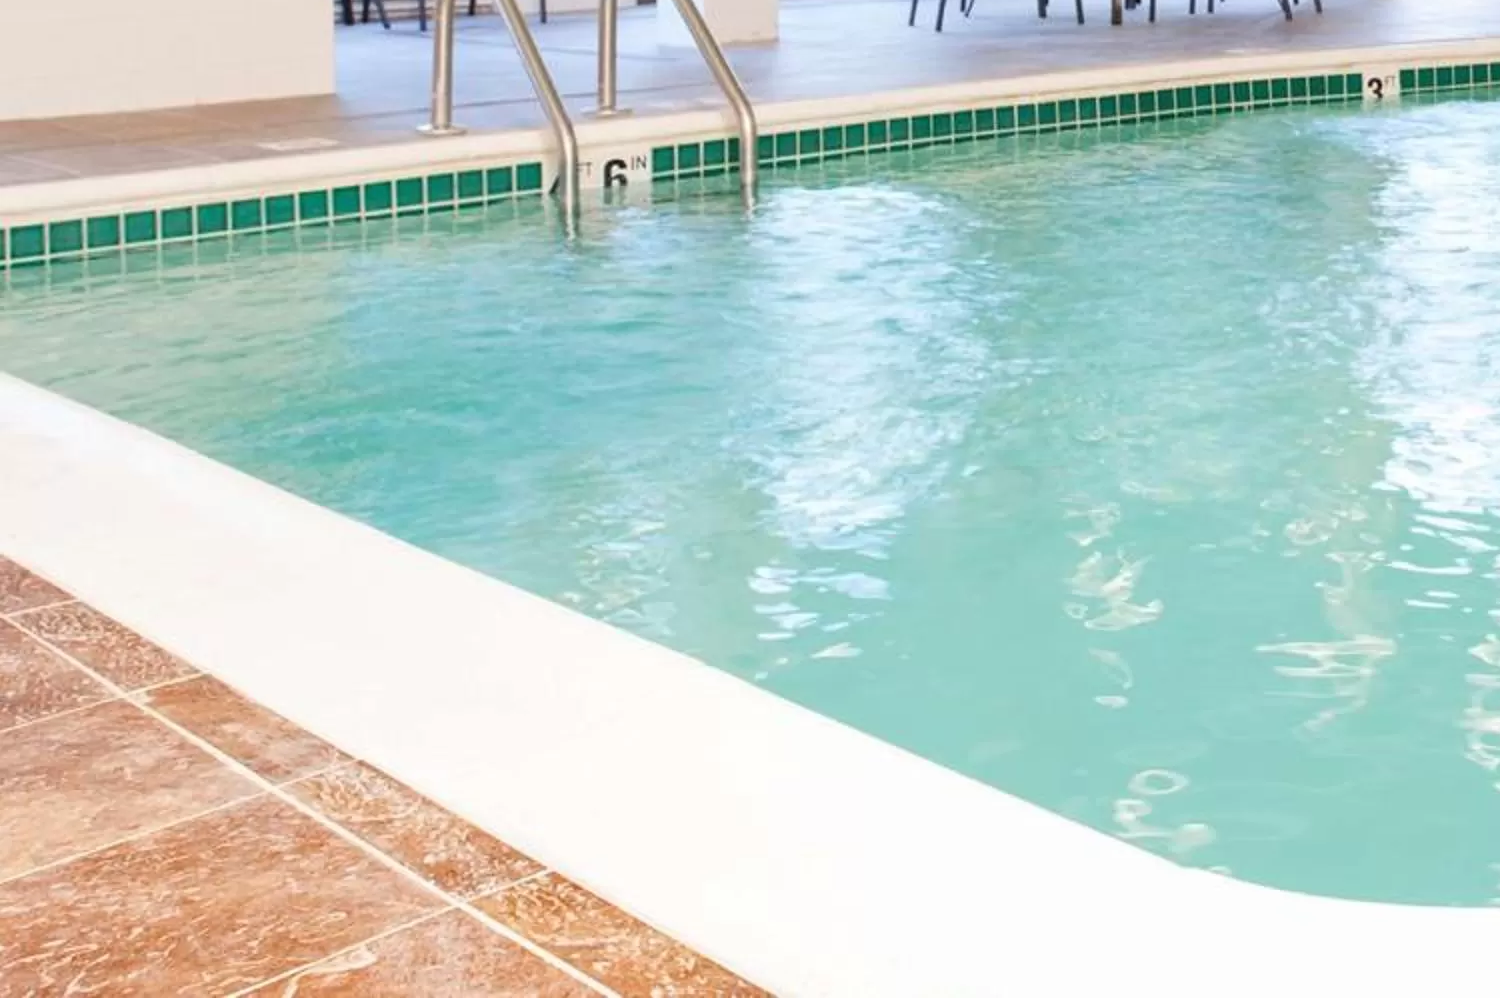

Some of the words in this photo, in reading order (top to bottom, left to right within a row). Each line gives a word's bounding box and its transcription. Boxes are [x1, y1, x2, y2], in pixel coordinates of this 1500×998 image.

[1367, 78, 1383, 99] 3
[603, 159, 627, 188] 6
[630, 153, 647, 171] IN
